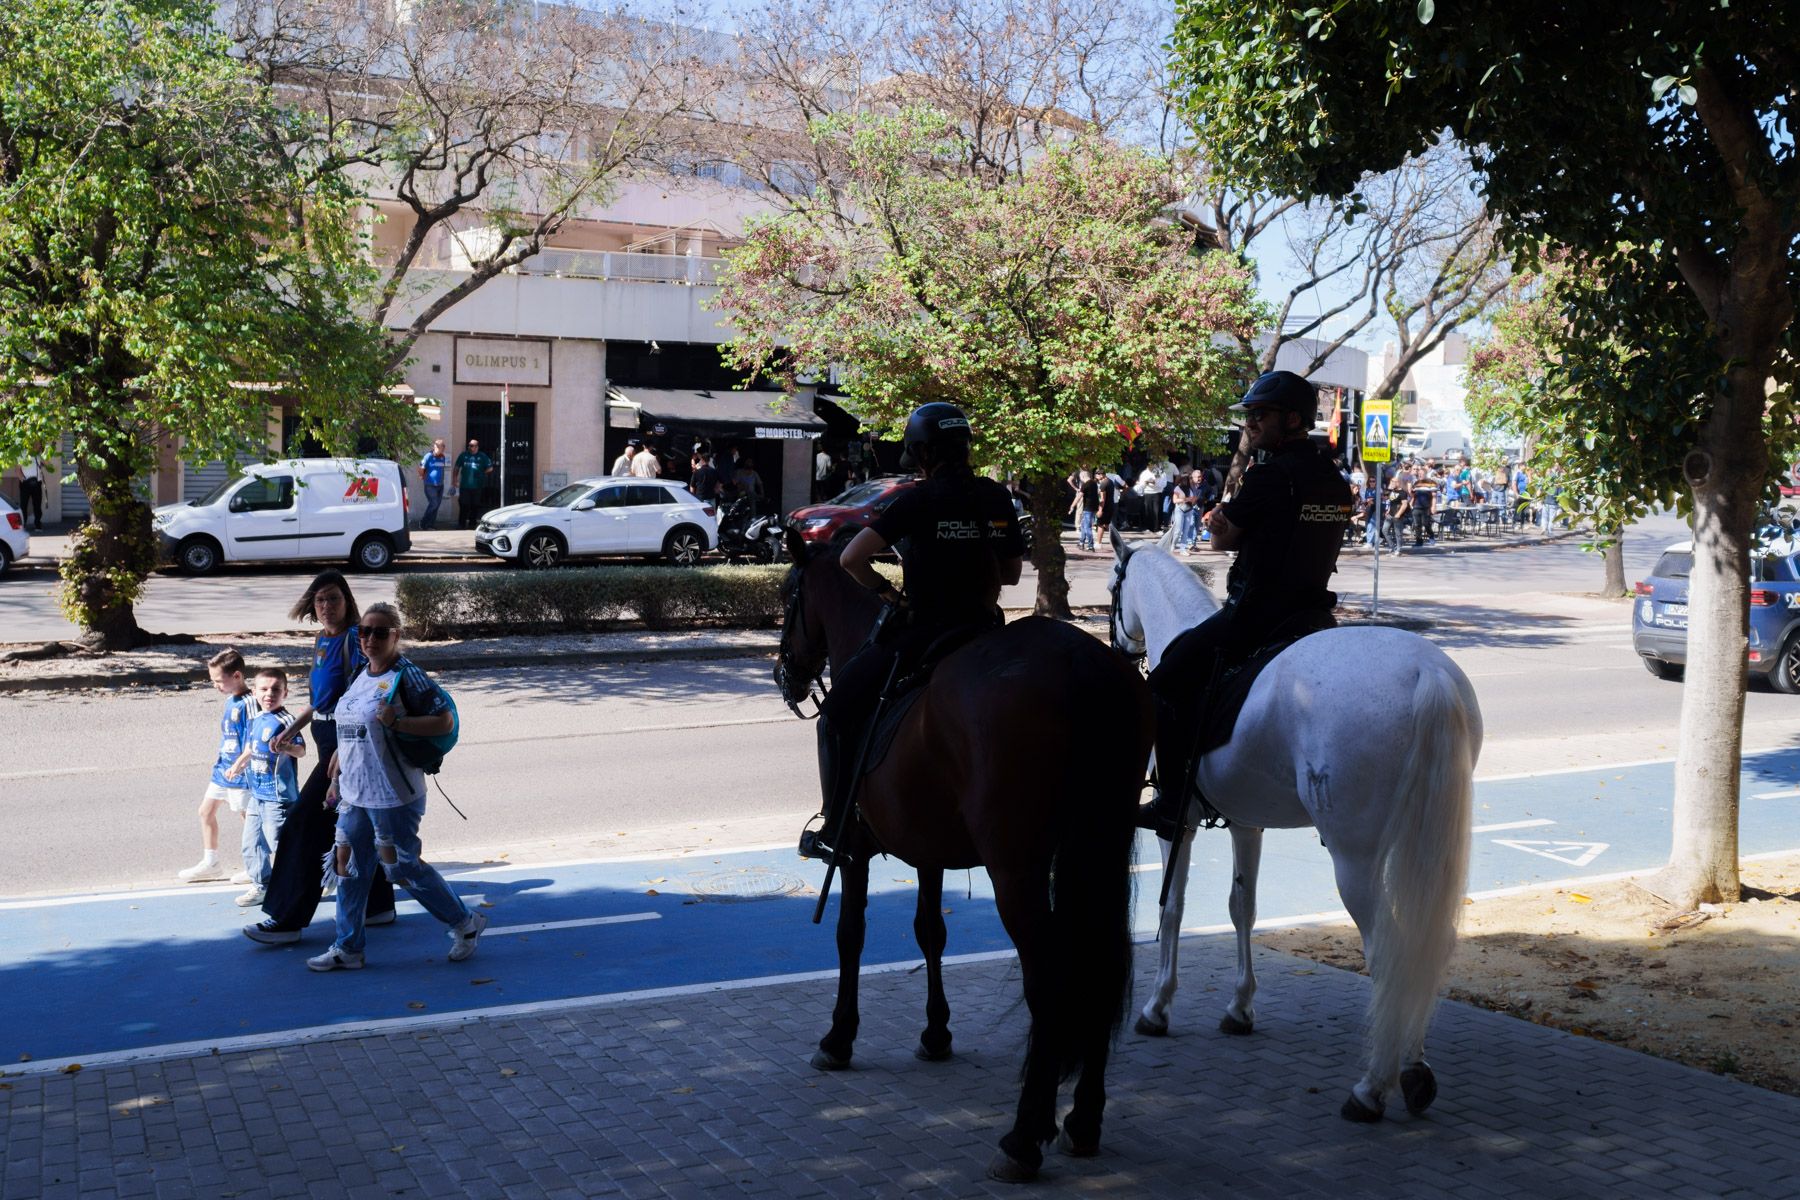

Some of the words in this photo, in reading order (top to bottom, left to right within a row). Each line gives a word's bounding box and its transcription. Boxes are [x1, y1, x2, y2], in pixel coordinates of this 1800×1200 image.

[465, 354, 527, 369] OLIMPUS
[533, 358, 540, 369] 1
[765, 427, 803, 439] MONSTER
[1302, 504, 1342, 513] POLICIA
[1300, 513, 1348, 521] NACIONAL
[937, 520, 995, 530] POLIA
[1656, 618, 1688, 628] POLIC
